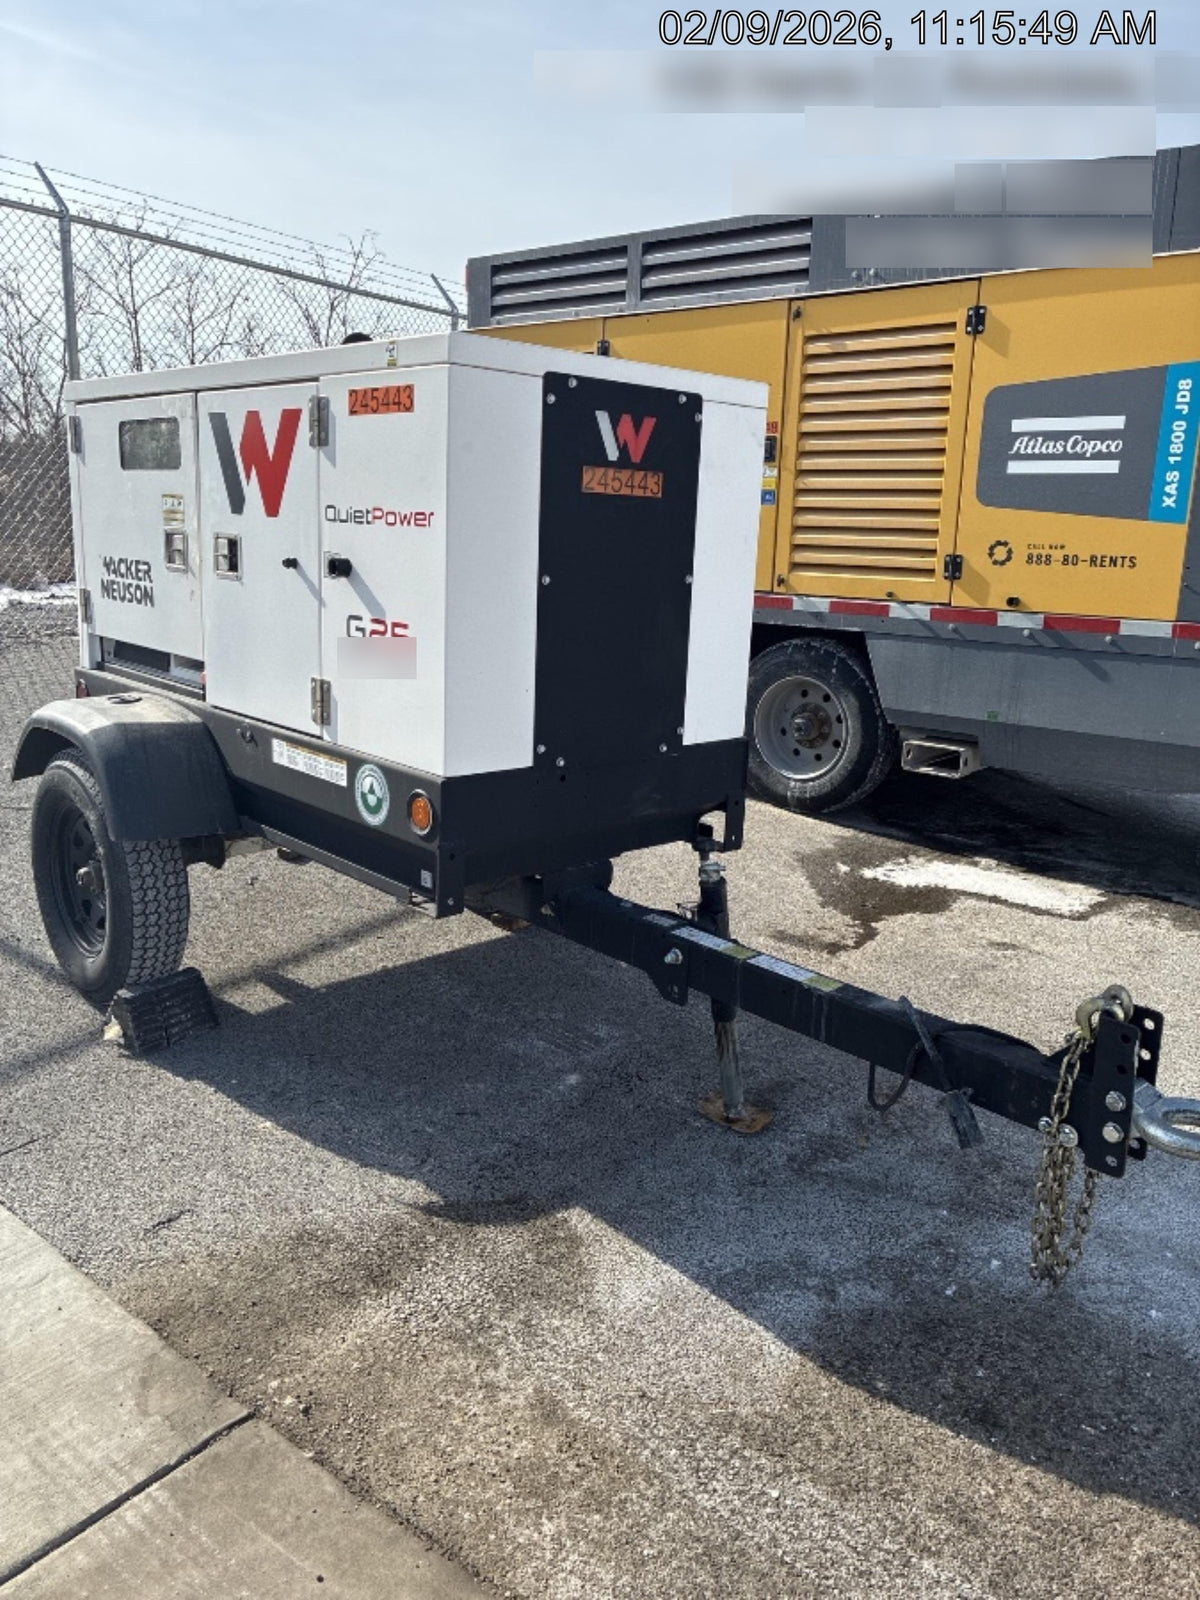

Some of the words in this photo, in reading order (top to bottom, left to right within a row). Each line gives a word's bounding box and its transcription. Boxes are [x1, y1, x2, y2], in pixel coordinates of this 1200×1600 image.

[349, 385, 414, 414] 245443
[1008, 435, 1065, 455] Atlas
[1066, 434, 1124, 458] Copco
[1167, 420, 1187, 465] 1800
[584, 467, 661, 496] 245443
[1162, 470, 1180, 509] XAS
[1025, 552, 1138, 569] 888-80-RENTS
[100, 577, 155, 608] NEUSON
